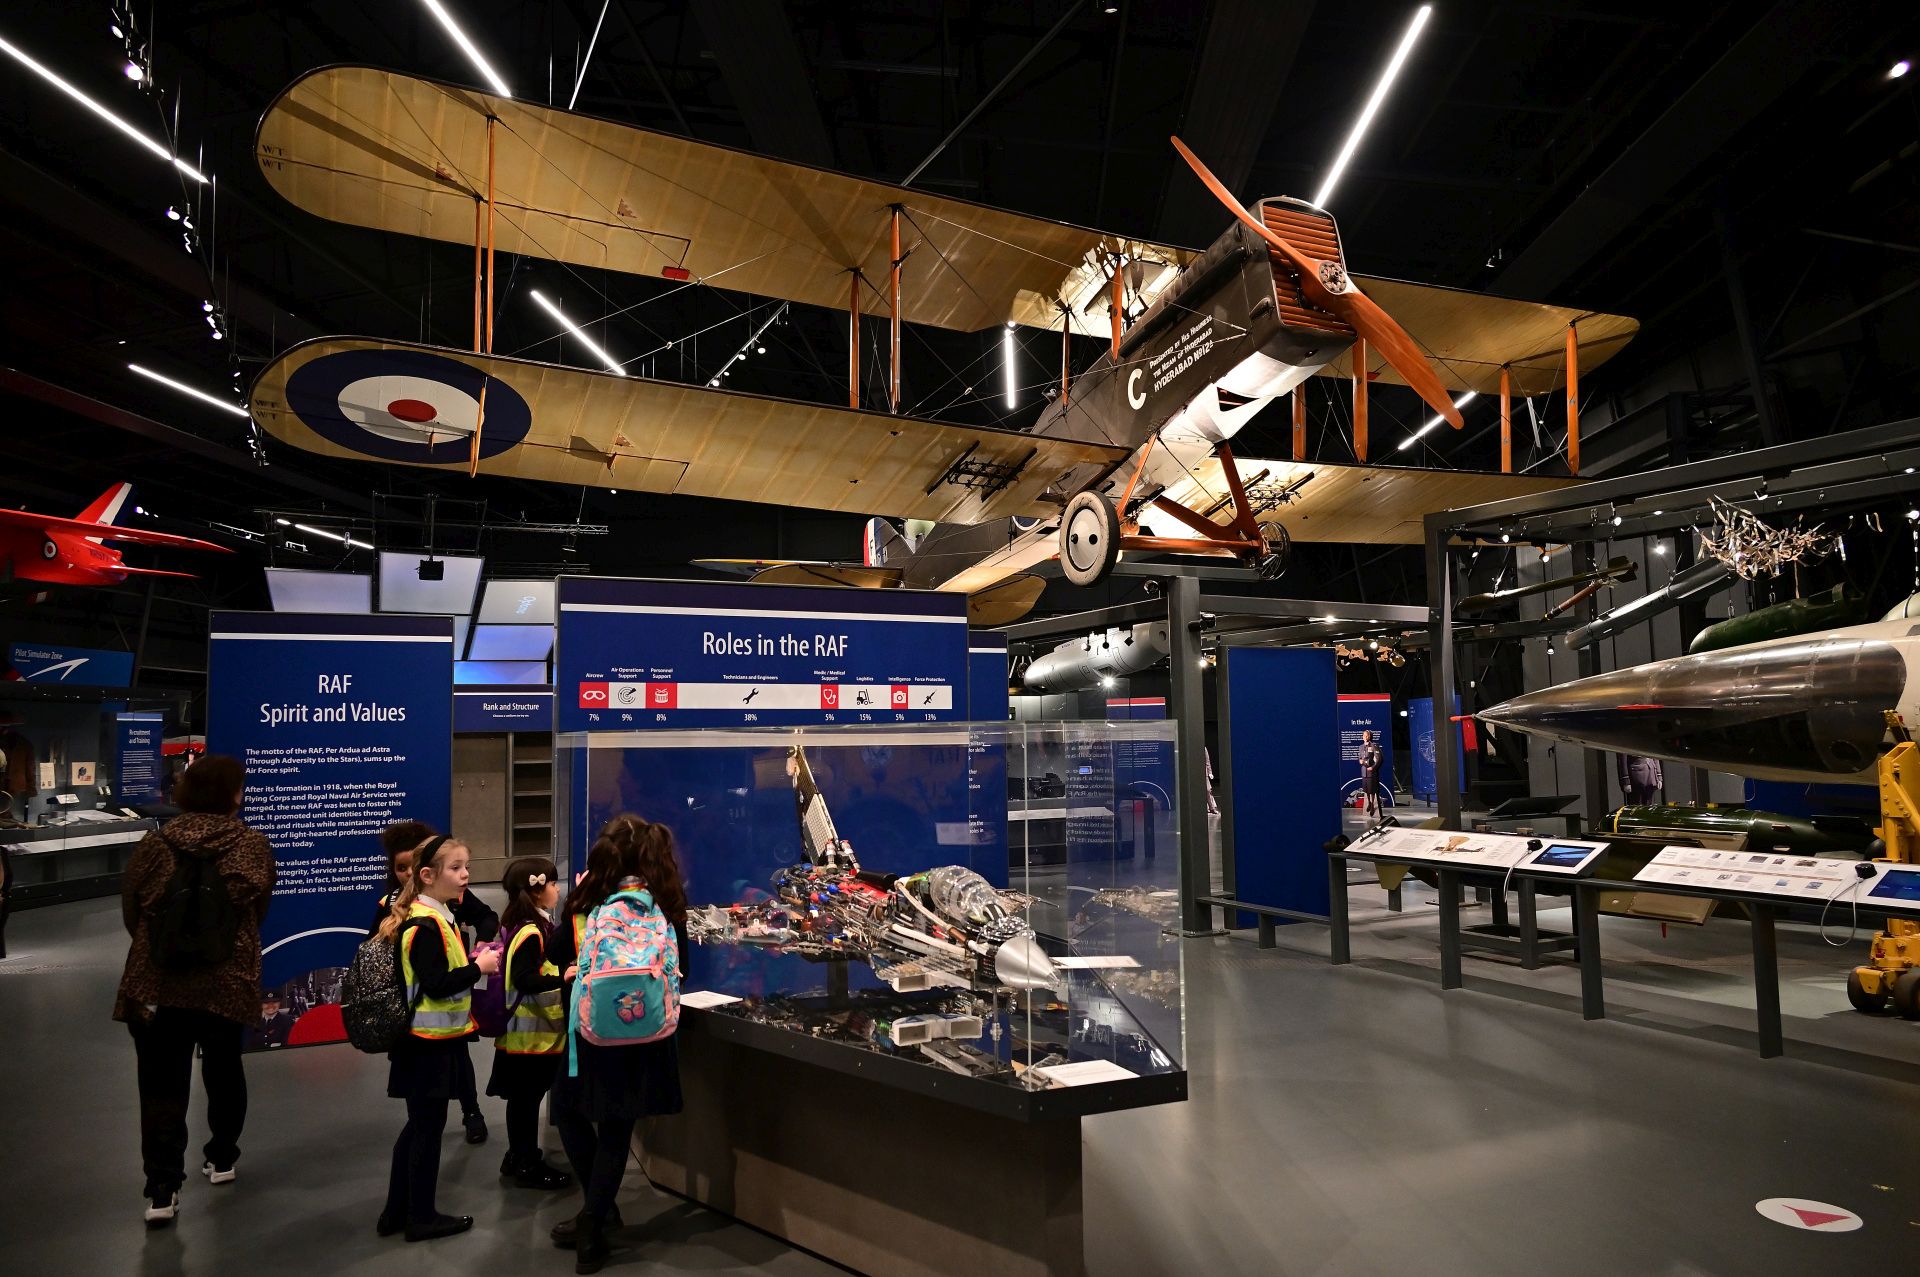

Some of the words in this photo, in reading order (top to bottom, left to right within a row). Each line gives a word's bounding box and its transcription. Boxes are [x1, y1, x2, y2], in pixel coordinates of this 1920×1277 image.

[1154, 356, 1193, 392] HYDERABAD
[1128, 369, 1146, 410] C
[704, 632, 751, 655] Roles
[758, 634, 774, 655] in
[780, 634, 809, 656] the
[815, 635, 848, 657] RAF
[28, 650, 50, 658] Simulator
[319, 675, 352, 693] RAF
[260, 704, 308, 727] Spirit
[313, 703, 346, 722] and
[350, 702, 406, 722] Values
[274, 813, 310, 821] promoted
[338, 819, 380, 828] maintaining
[290, 830, 337, 839] light-hearted
[339, 828, 386, 837] professionali
